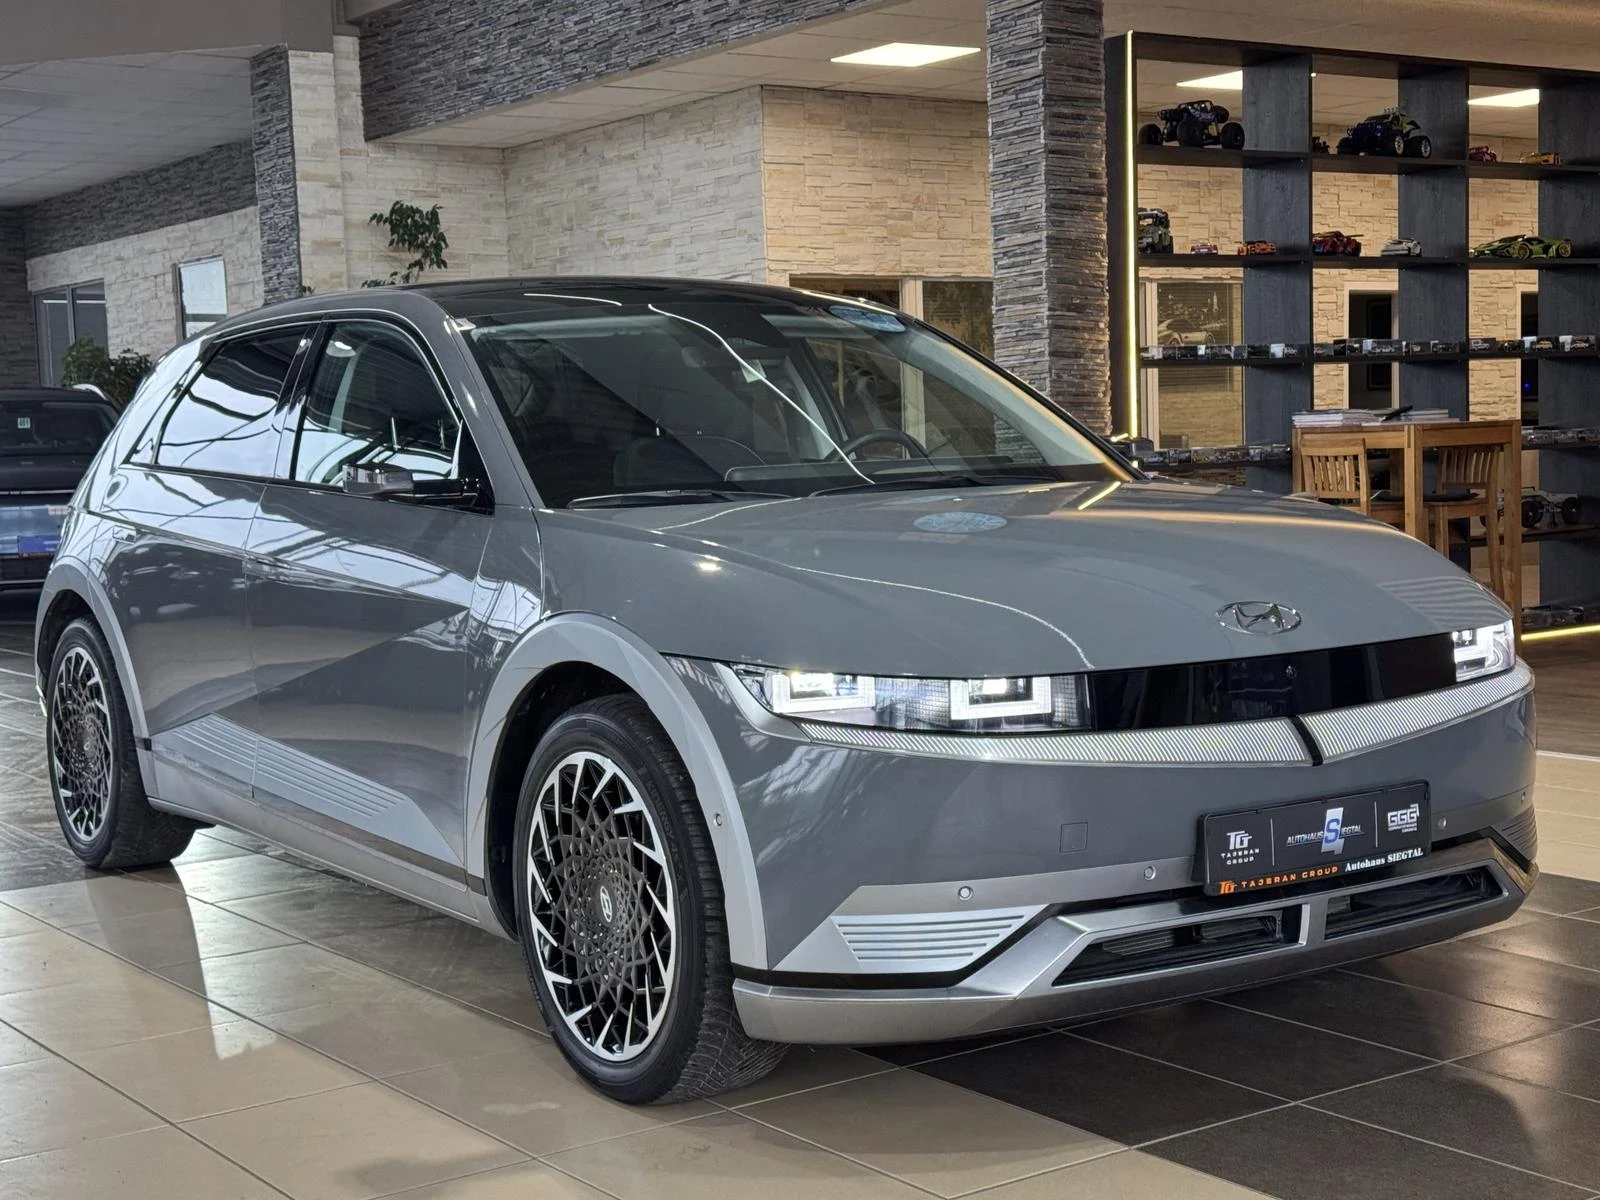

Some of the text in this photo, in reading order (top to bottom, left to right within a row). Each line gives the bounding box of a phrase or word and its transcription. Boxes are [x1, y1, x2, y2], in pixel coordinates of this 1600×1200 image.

[1286, 831, 1324, 845] AUTOHAUS
[1226, 856, 1255, 865] GROUP
[1344, 847, 1424, 873] Autohaus SIEGTAL
[1301, 866, 1338, 879] GROUP
